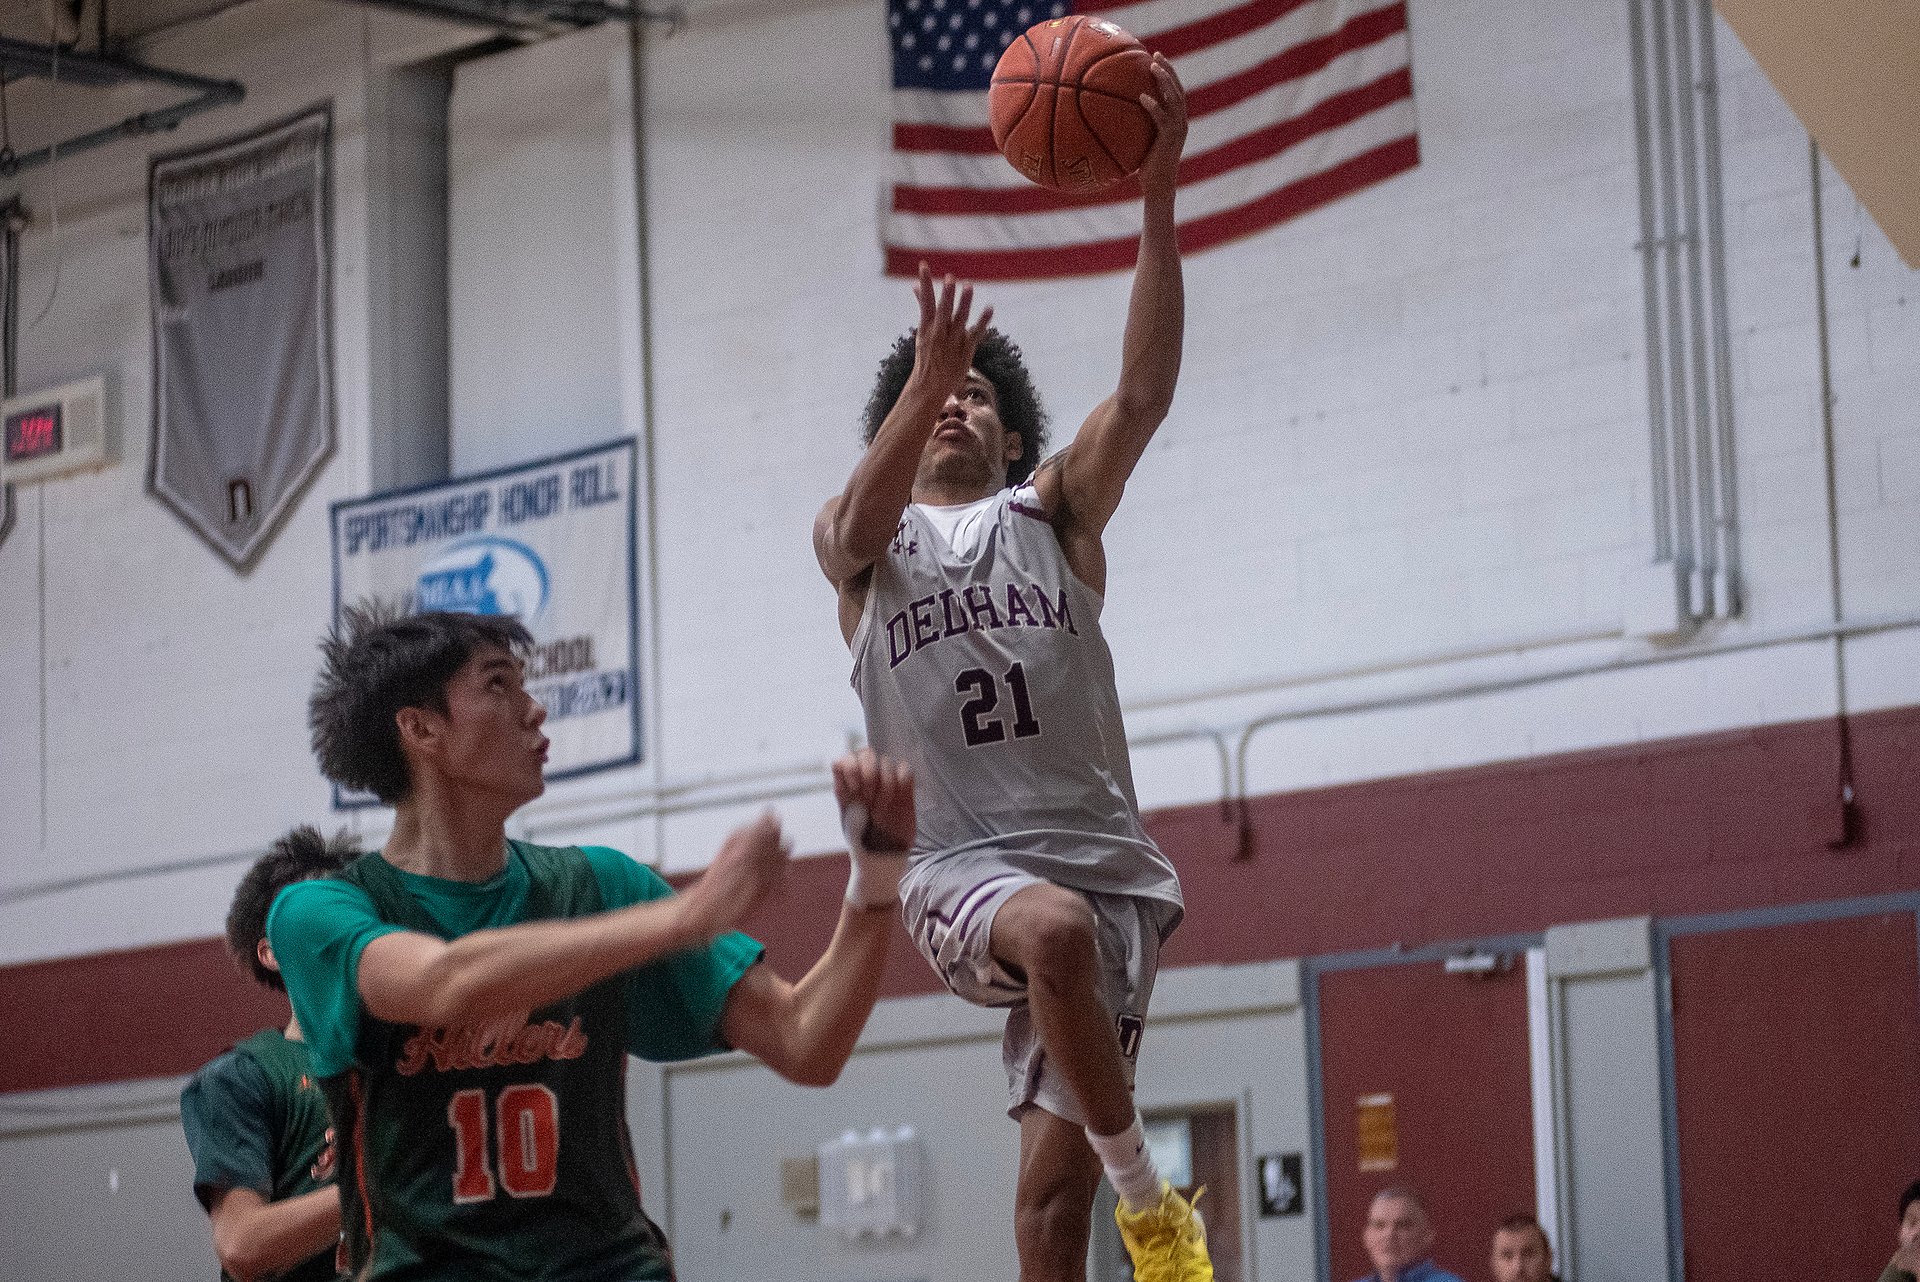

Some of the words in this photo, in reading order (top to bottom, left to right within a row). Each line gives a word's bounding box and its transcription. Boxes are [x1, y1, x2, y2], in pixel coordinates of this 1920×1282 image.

[345, 490, 491, 555] SPORTSMANSHIP
[499, 472, 562, 526] HONOR
[570, 459, 620, 509] ROLL
[886, 582, 1079, 672] DEDHAM
[954, 660, 1042, 748] 21
[448, 1082, 560, 1205] 10
